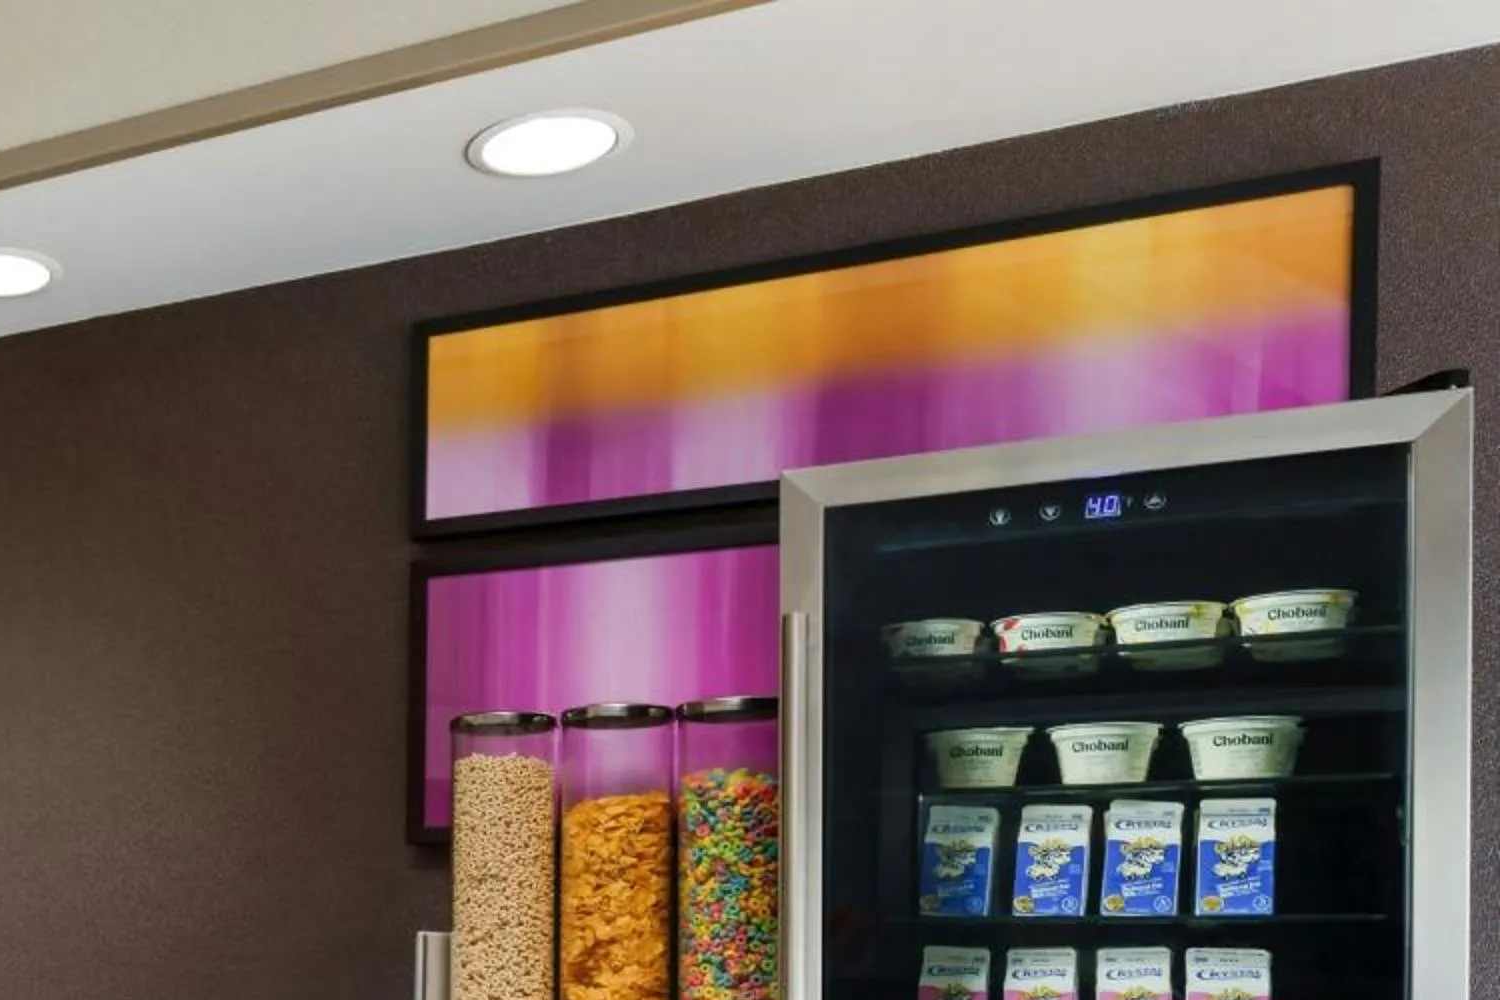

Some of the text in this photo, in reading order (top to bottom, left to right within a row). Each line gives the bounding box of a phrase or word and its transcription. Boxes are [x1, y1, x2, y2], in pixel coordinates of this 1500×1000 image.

[1088, 495, 1119, 514] 40
[1267, 605, 1327, 621] Chobani
[1135, 616, 1190, 632] Chobani
[1021, 625, 1073, 641] Chobani
[1072, 738, 1129, 753] Chobani
[1213, 733, 1274, 747] Chobani
